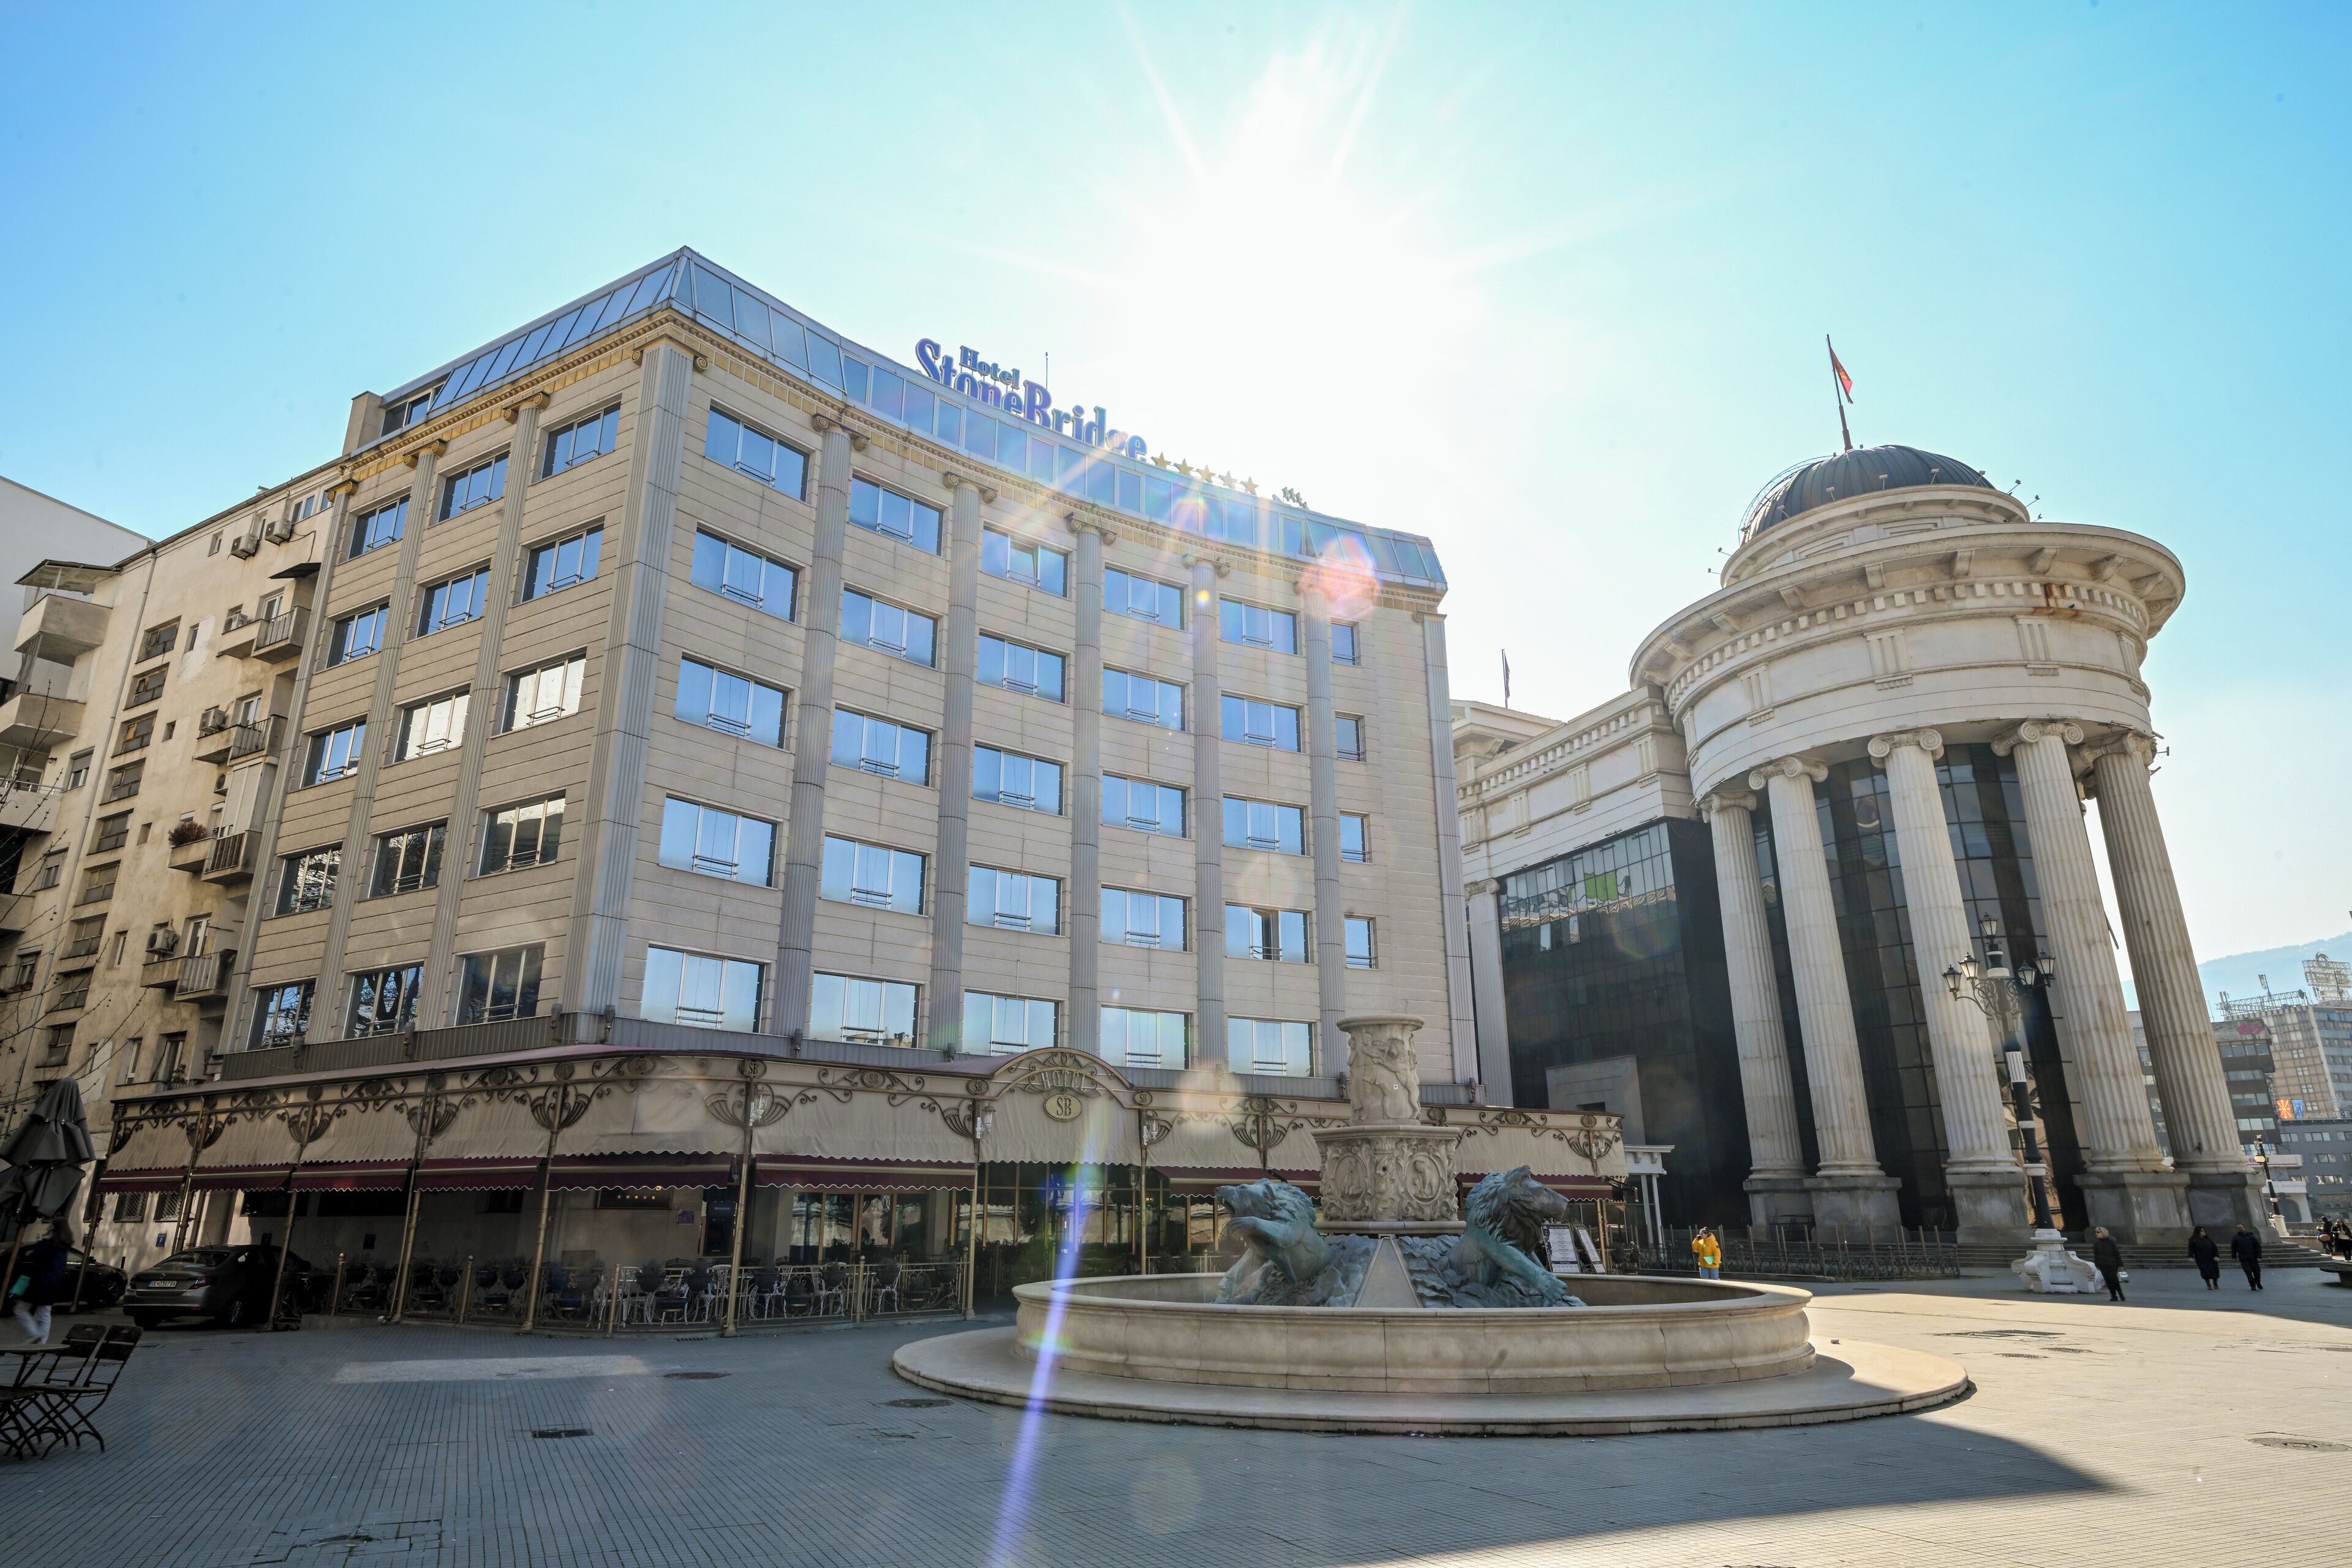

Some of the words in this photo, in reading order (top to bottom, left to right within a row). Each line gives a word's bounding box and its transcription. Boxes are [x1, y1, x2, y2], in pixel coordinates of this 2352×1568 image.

[959, 345, 1020, 390] Hotel
[748, 1063, 758, 1074] SB
[869, 1073, 878, 1084] SB
[1041, 1070, 1087, 1092] HOTEL
[974, 1082, 982, 1092] SB
[1139, 1093, 1147, 1103] SB
[1056, 1097, 1072, 1116] SB
